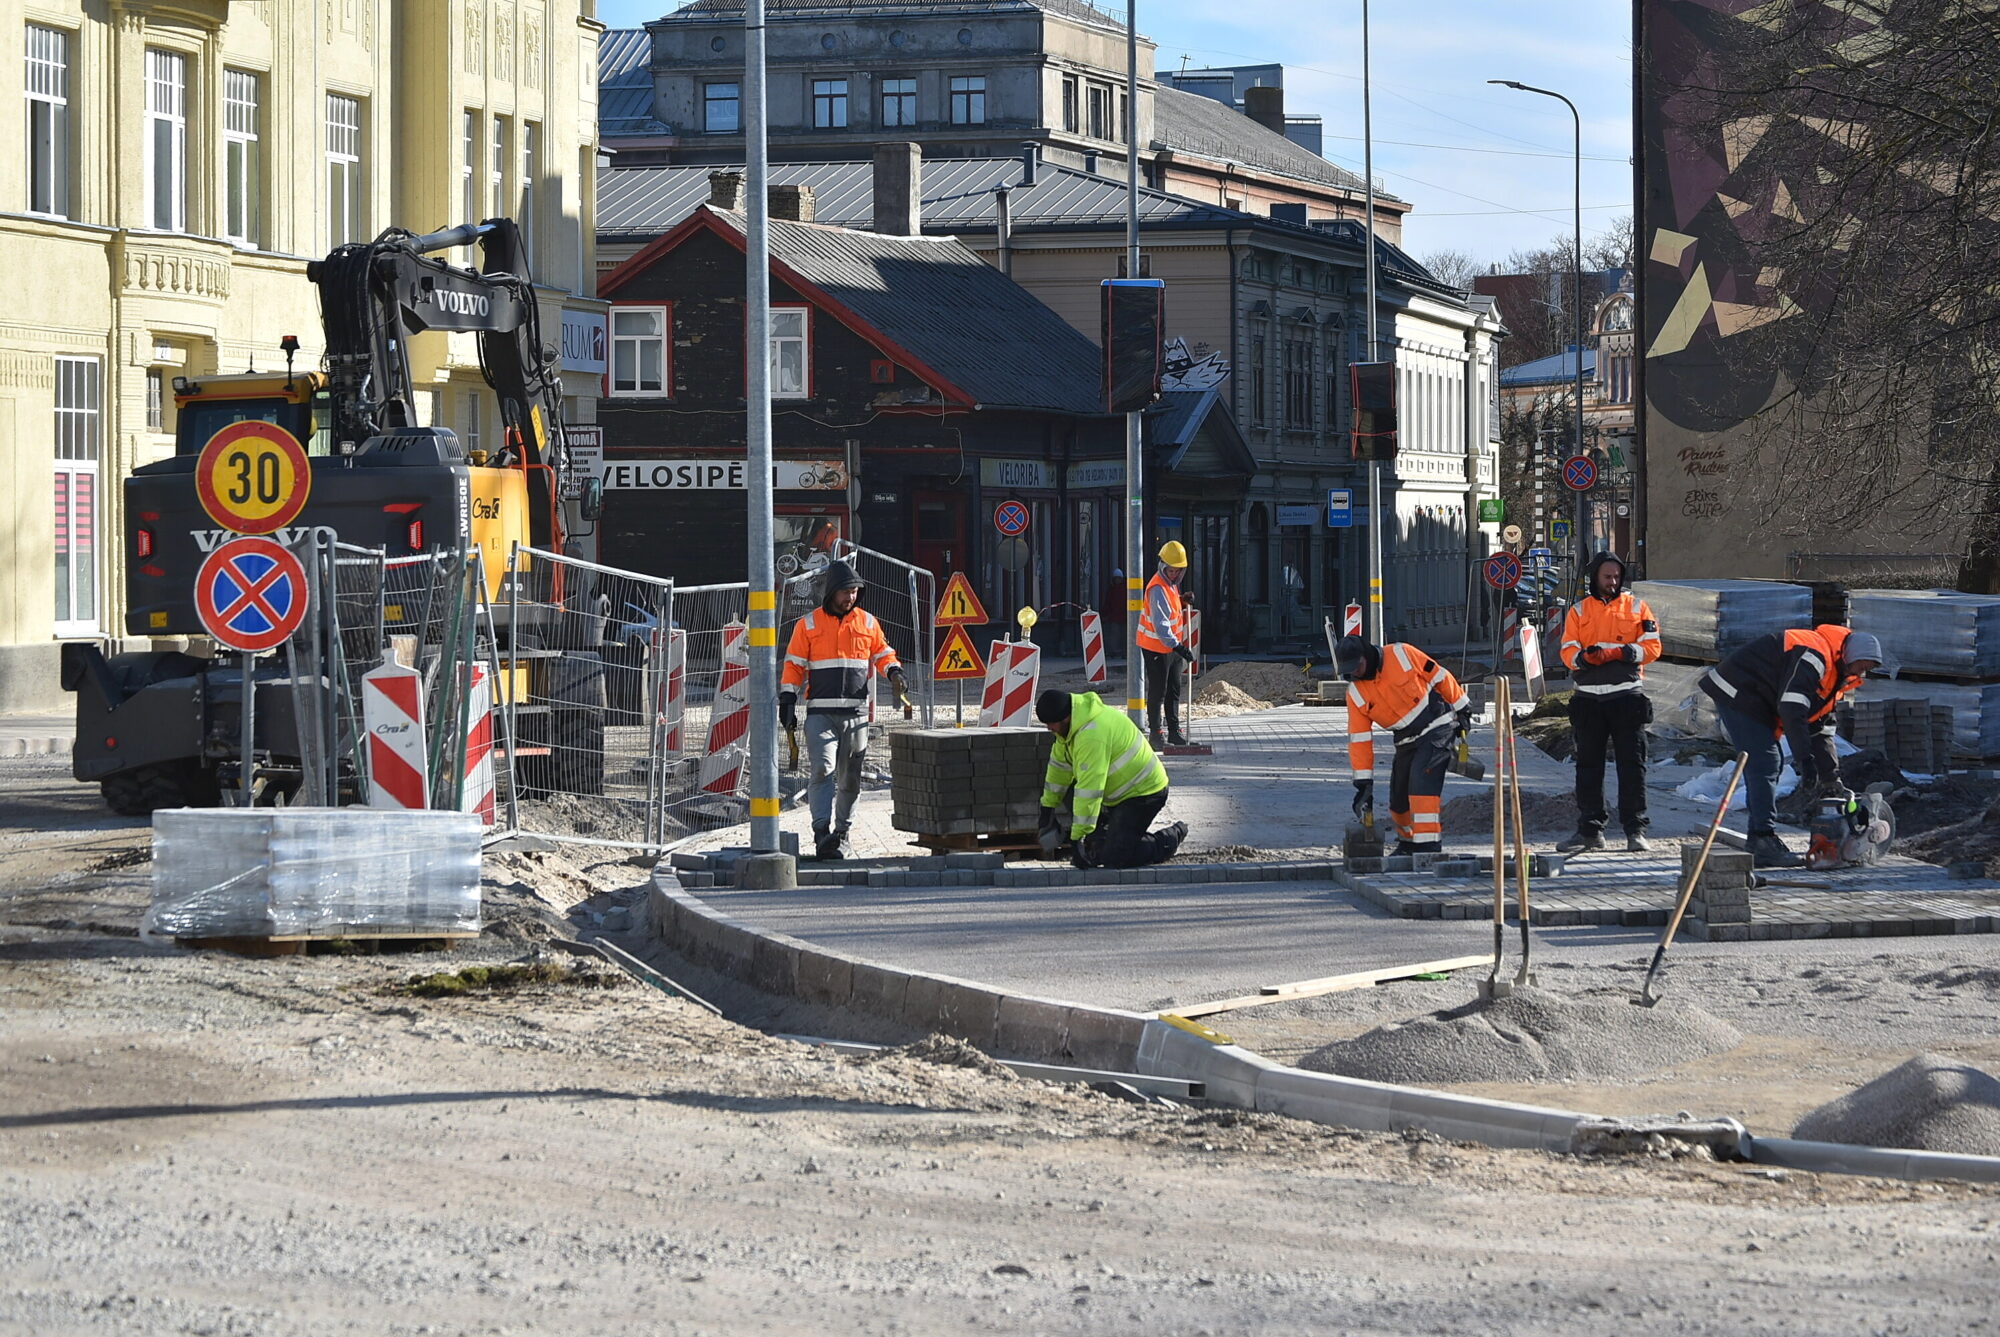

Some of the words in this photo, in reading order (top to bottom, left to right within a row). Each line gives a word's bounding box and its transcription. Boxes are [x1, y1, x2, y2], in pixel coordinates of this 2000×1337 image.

[435, 289, 489, 317] VOLVO
[228, 451, 280, 504] 30
[603, 462, 778, 488] VELOSIPĒI
[998, 462, 1040, 486] VELORIBA
